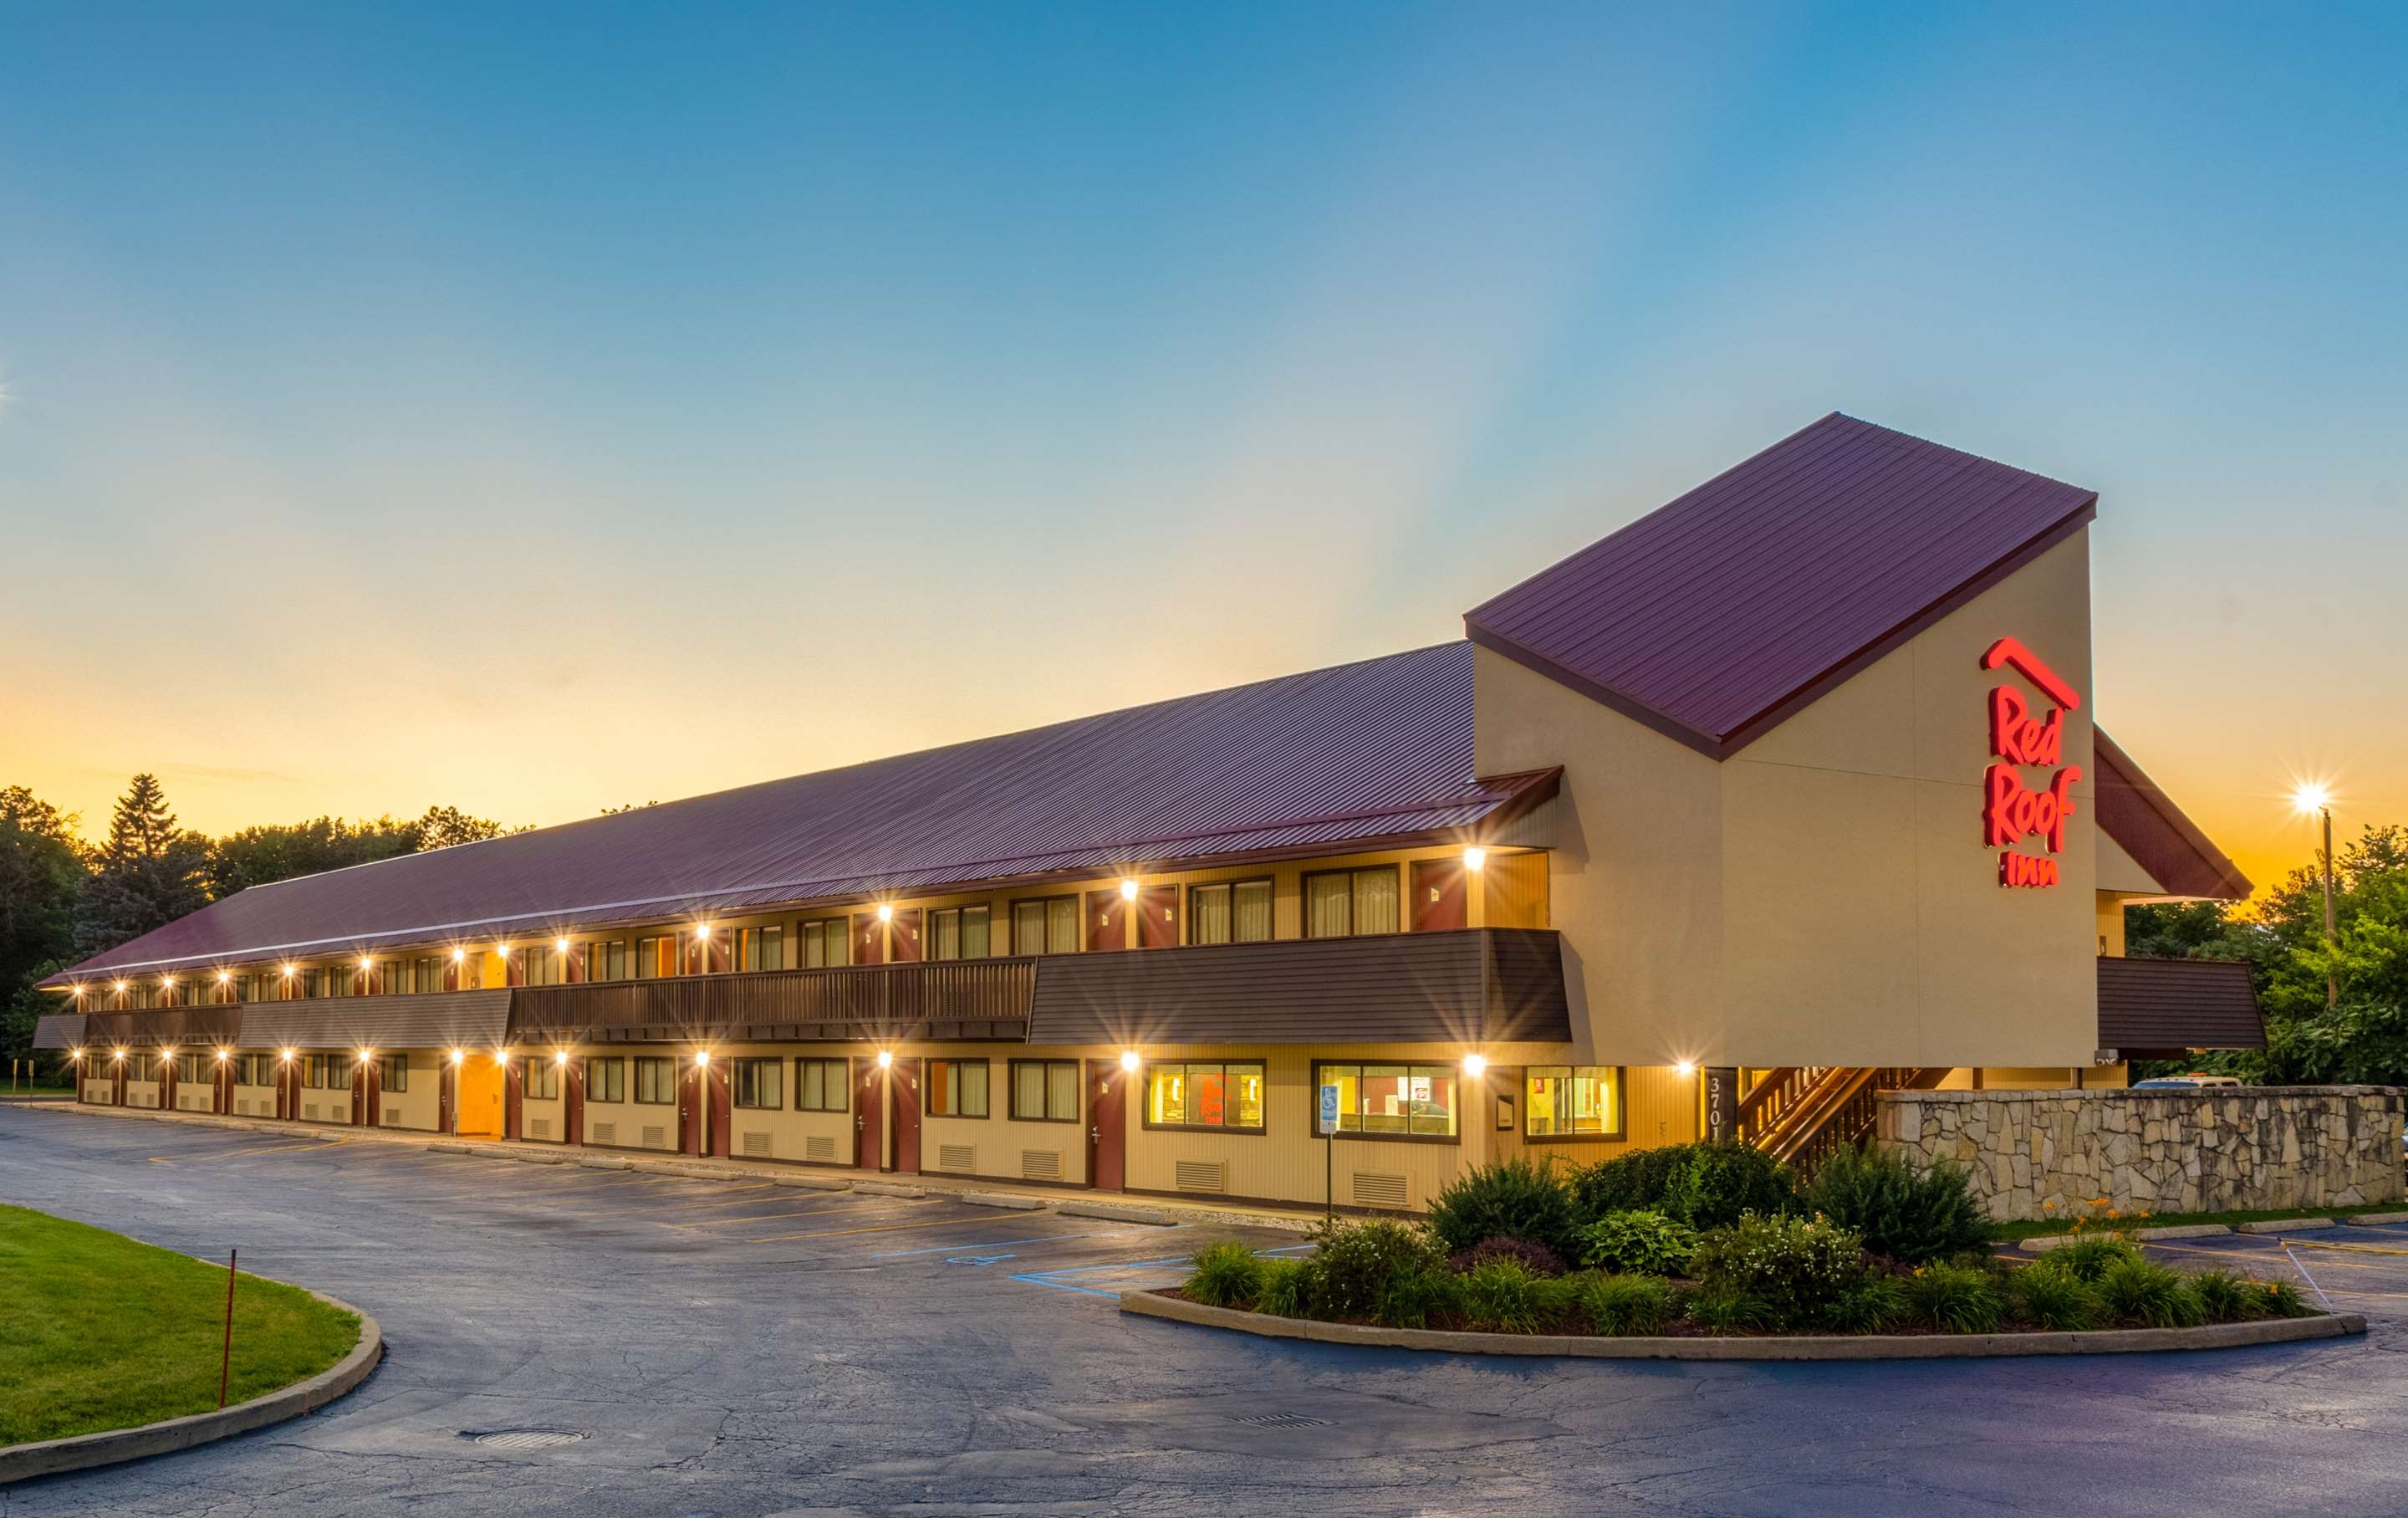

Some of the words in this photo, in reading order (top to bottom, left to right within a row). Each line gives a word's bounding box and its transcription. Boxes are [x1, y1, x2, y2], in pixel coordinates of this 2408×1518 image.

[1989, 684, 2064, 764] Red
[1984, 763, 2083, 853] Roof
[1710, 1077, 1721, 1142] 3701
